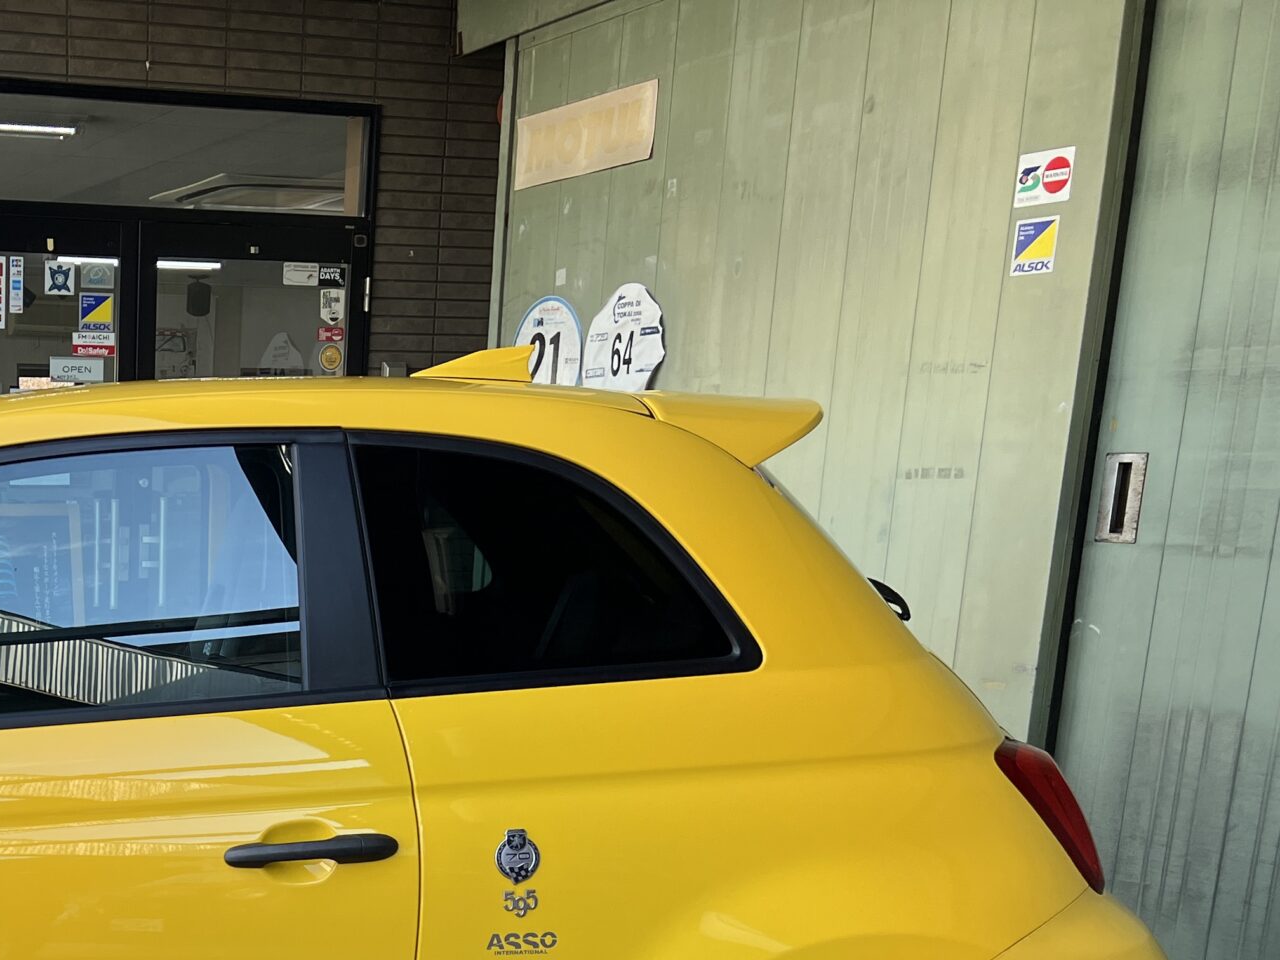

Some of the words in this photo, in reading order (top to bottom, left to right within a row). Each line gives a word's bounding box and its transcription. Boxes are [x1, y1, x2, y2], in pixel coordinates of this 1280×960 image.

[1013, 260, 1051, 273] ALSOK
[319, 272, 340, 280] DAYS
[617, 301, 634, 310] COPPA
[81, 323, 111, 331] ALSOK
[529, 331, 561, 384] 21
[610, 330, 634, 377] 64
[62, 365, 92, 374] OPEN
[505, 851, 531, 861] 70
[503, 889, 539, 918] 595
[486, 931, 558, 951] ASSO
